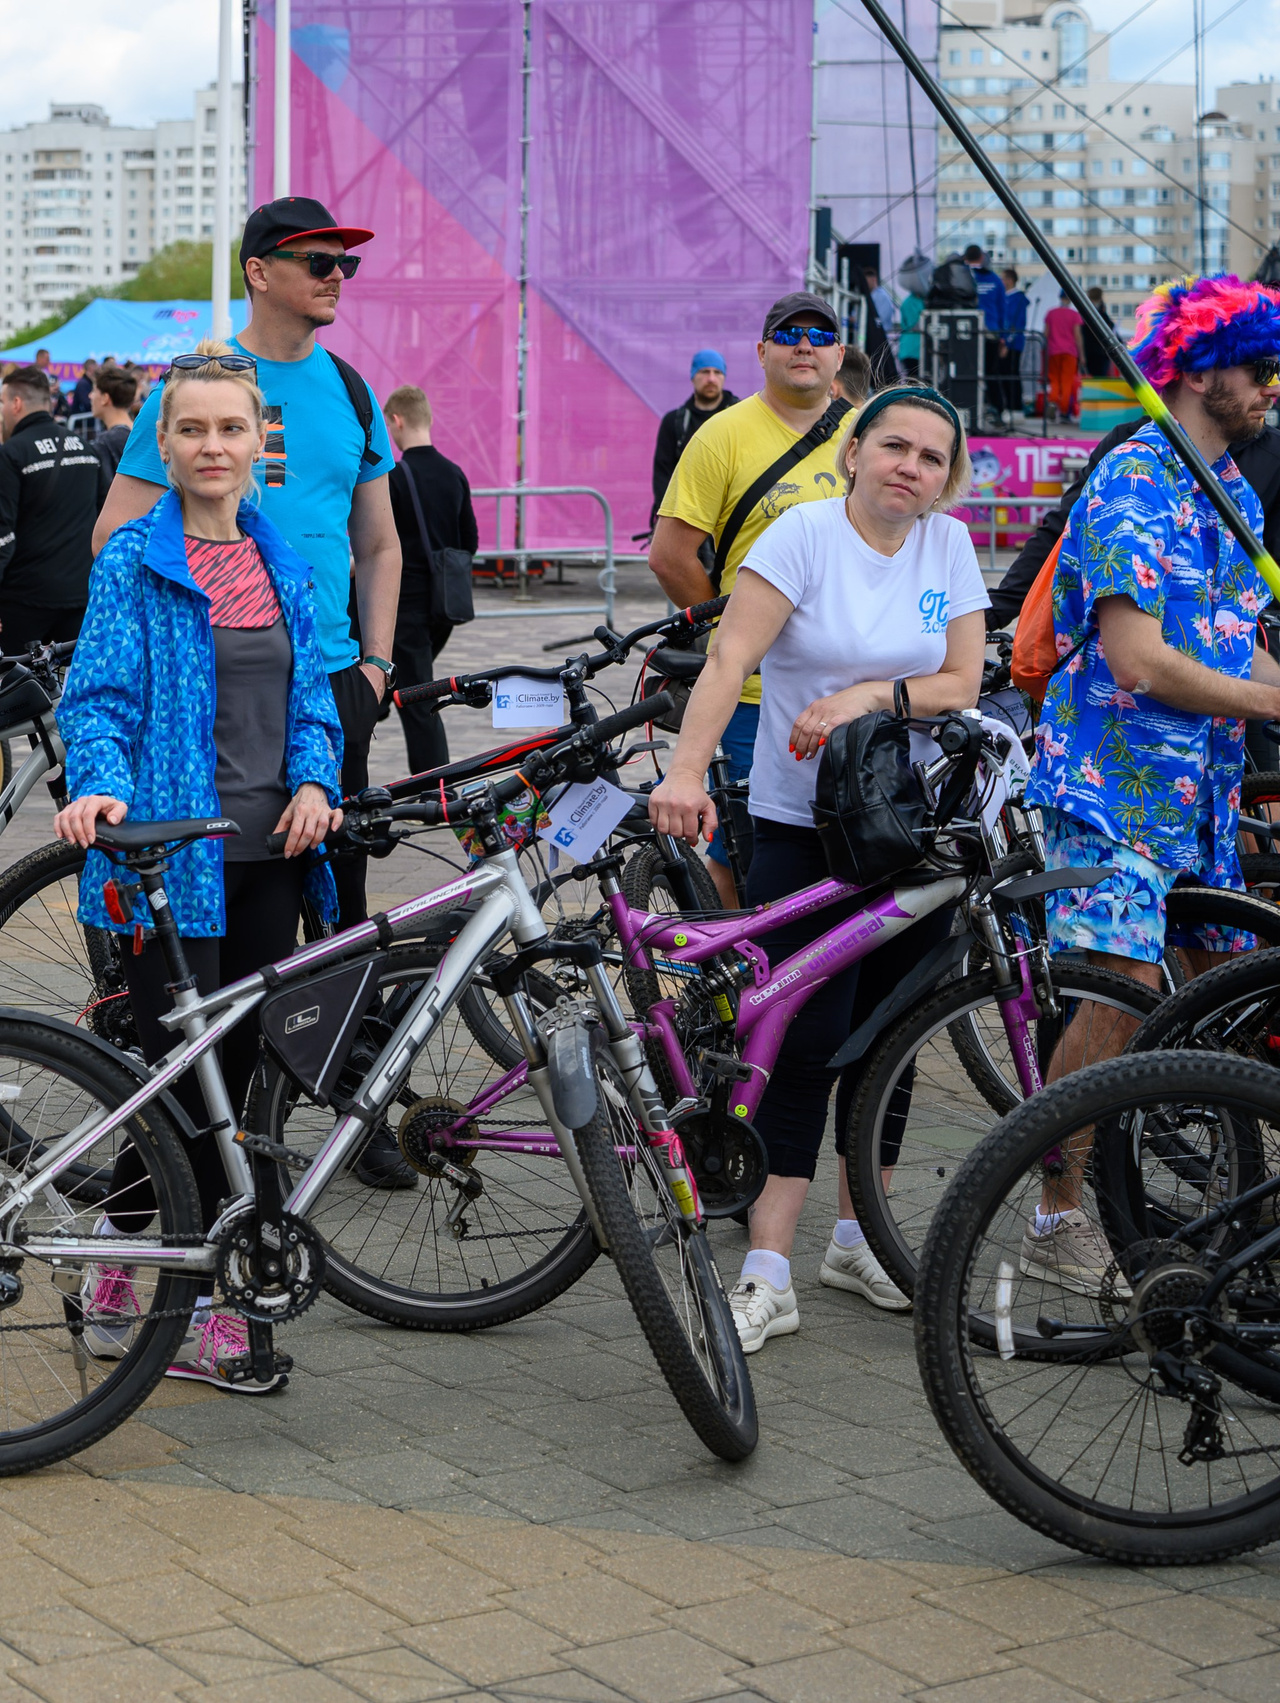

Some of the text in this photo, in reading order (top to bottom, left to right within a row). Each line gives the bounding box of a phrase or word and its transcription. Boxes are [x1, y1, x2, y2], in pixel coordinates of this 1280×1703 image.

[516, 693, 560, 703] iClimate.by
[569, 784, 607, 826] iClimate.by
[206, 822, 230, 830] GT
[400, 883, 466, 914] AVALANCHE
[808, 913, 885, 972] universal
